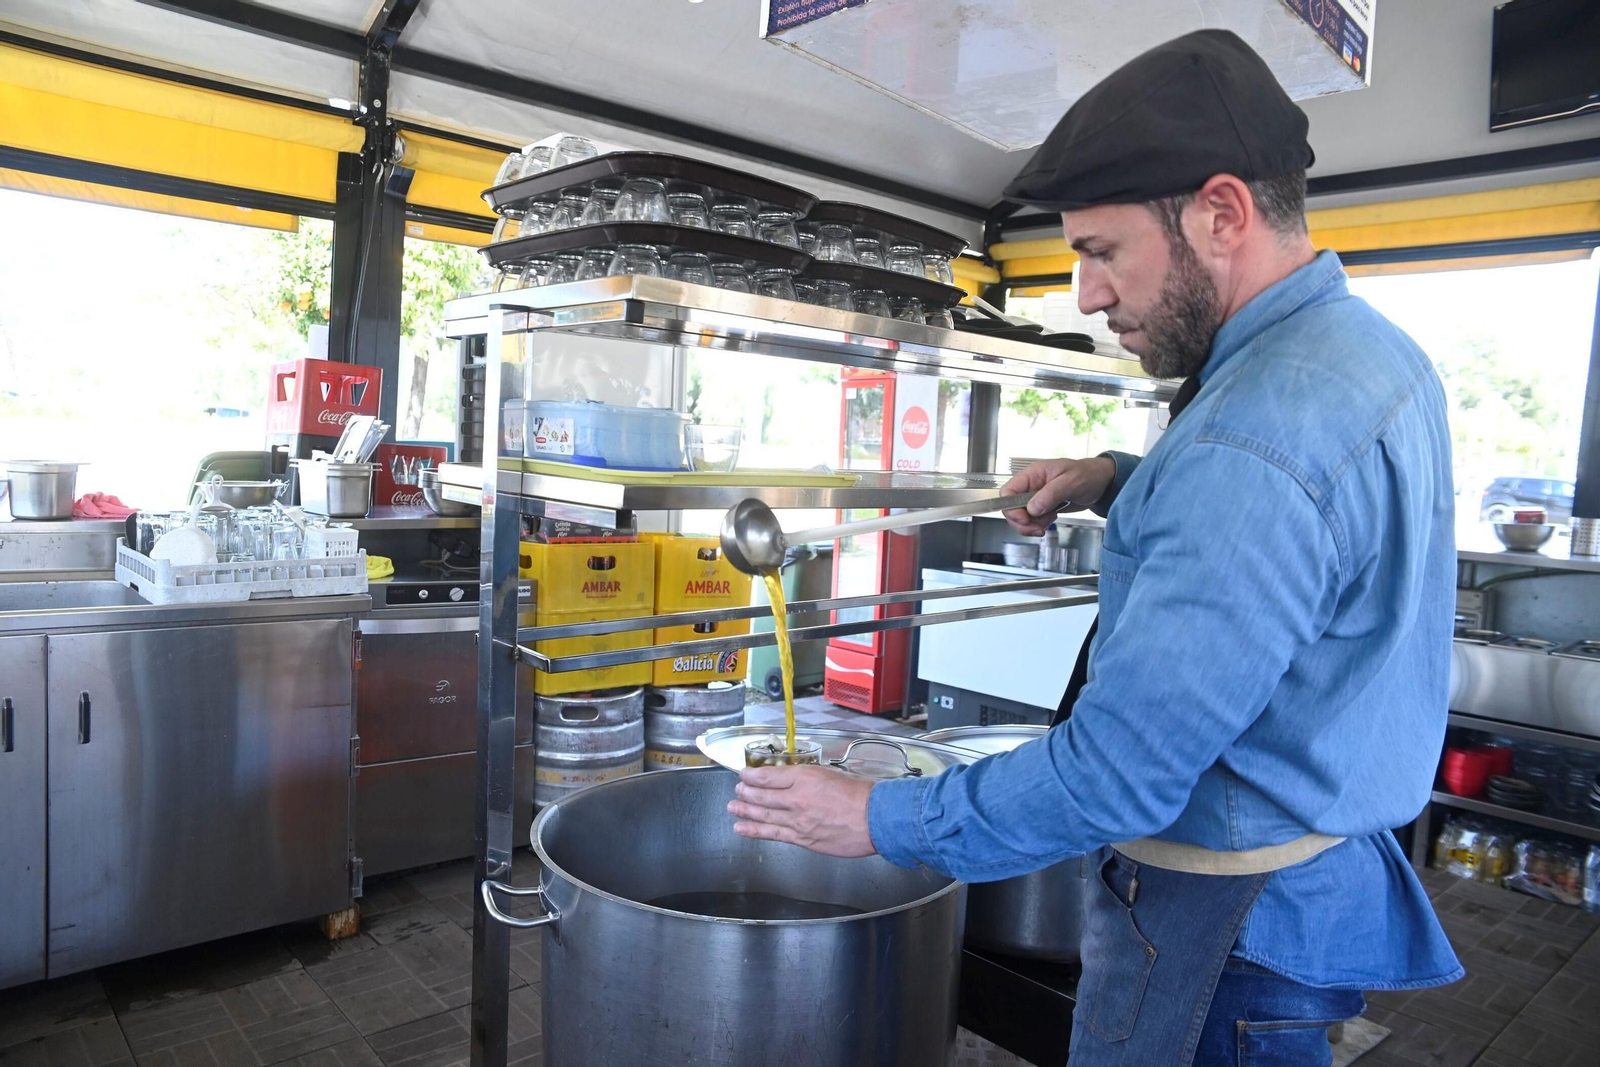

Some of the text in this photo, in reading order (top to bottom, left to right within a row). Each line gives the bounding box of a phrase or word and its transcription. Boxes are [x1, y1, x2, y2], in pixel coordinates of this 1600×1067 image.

[777, 11, 807, 27] Prohibida
[318, 409, 362, 425] Coca-Co
[902, 420, 929, 434] Coca-Cola
[897, 459, 920, 468] COLD
[581, 581, 621, 593] AMBAR
[684, 580, 731, 594] AMBAR
[673, 655, 714, 673] Galicia
